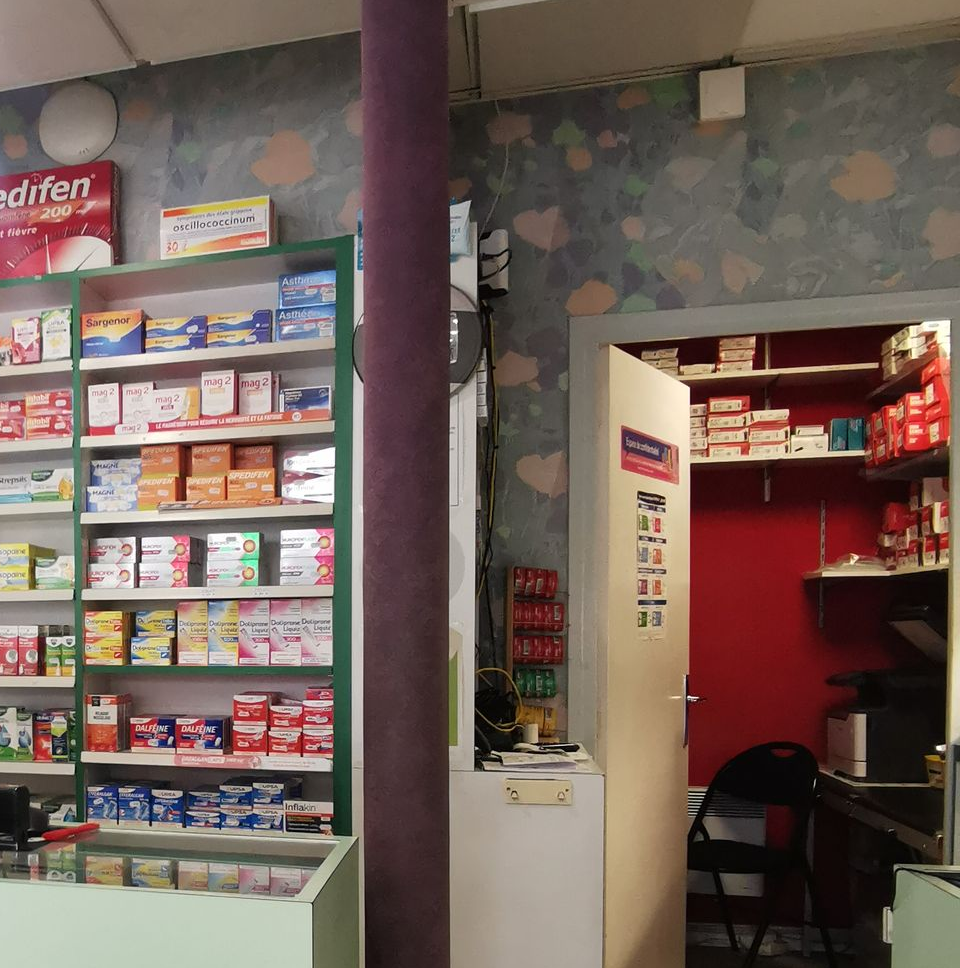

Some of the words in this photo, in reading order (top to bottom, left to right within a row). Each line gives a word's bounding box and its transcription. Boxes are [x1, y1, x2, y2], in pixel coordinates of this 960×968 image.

[41, 205, 72, 220] 200
[173, 213, 256, 232] oscillococcinum
[7, 226, 38, 238] fièvre
[86, 316, 132, 328] Sargenor
[204, 378, 223, 387] mag
[225, 376, 231, 385] 2
[241, 379, 260, 389] mag
[262, 378, 269, 386] 2
[92, 389, 107, 397] mag
[109, 388, 115, 396] 2
[126, 388, 141, 396] mag
[155, 396, 172, 404] mag
[174, 394, 180, 402] 2
[122, 425, 136, 433] mag
[229, 471, 271, 480] SPEDIFEN
[189, 477, 223, 485] SPEDIFEN
[240, 620, 269, 628] Doliprane
[271, 619, 300, 627] Doliprane
[302, 618, 331, 626] Doliprane
[285, 802, 316, 812] Inflakin
